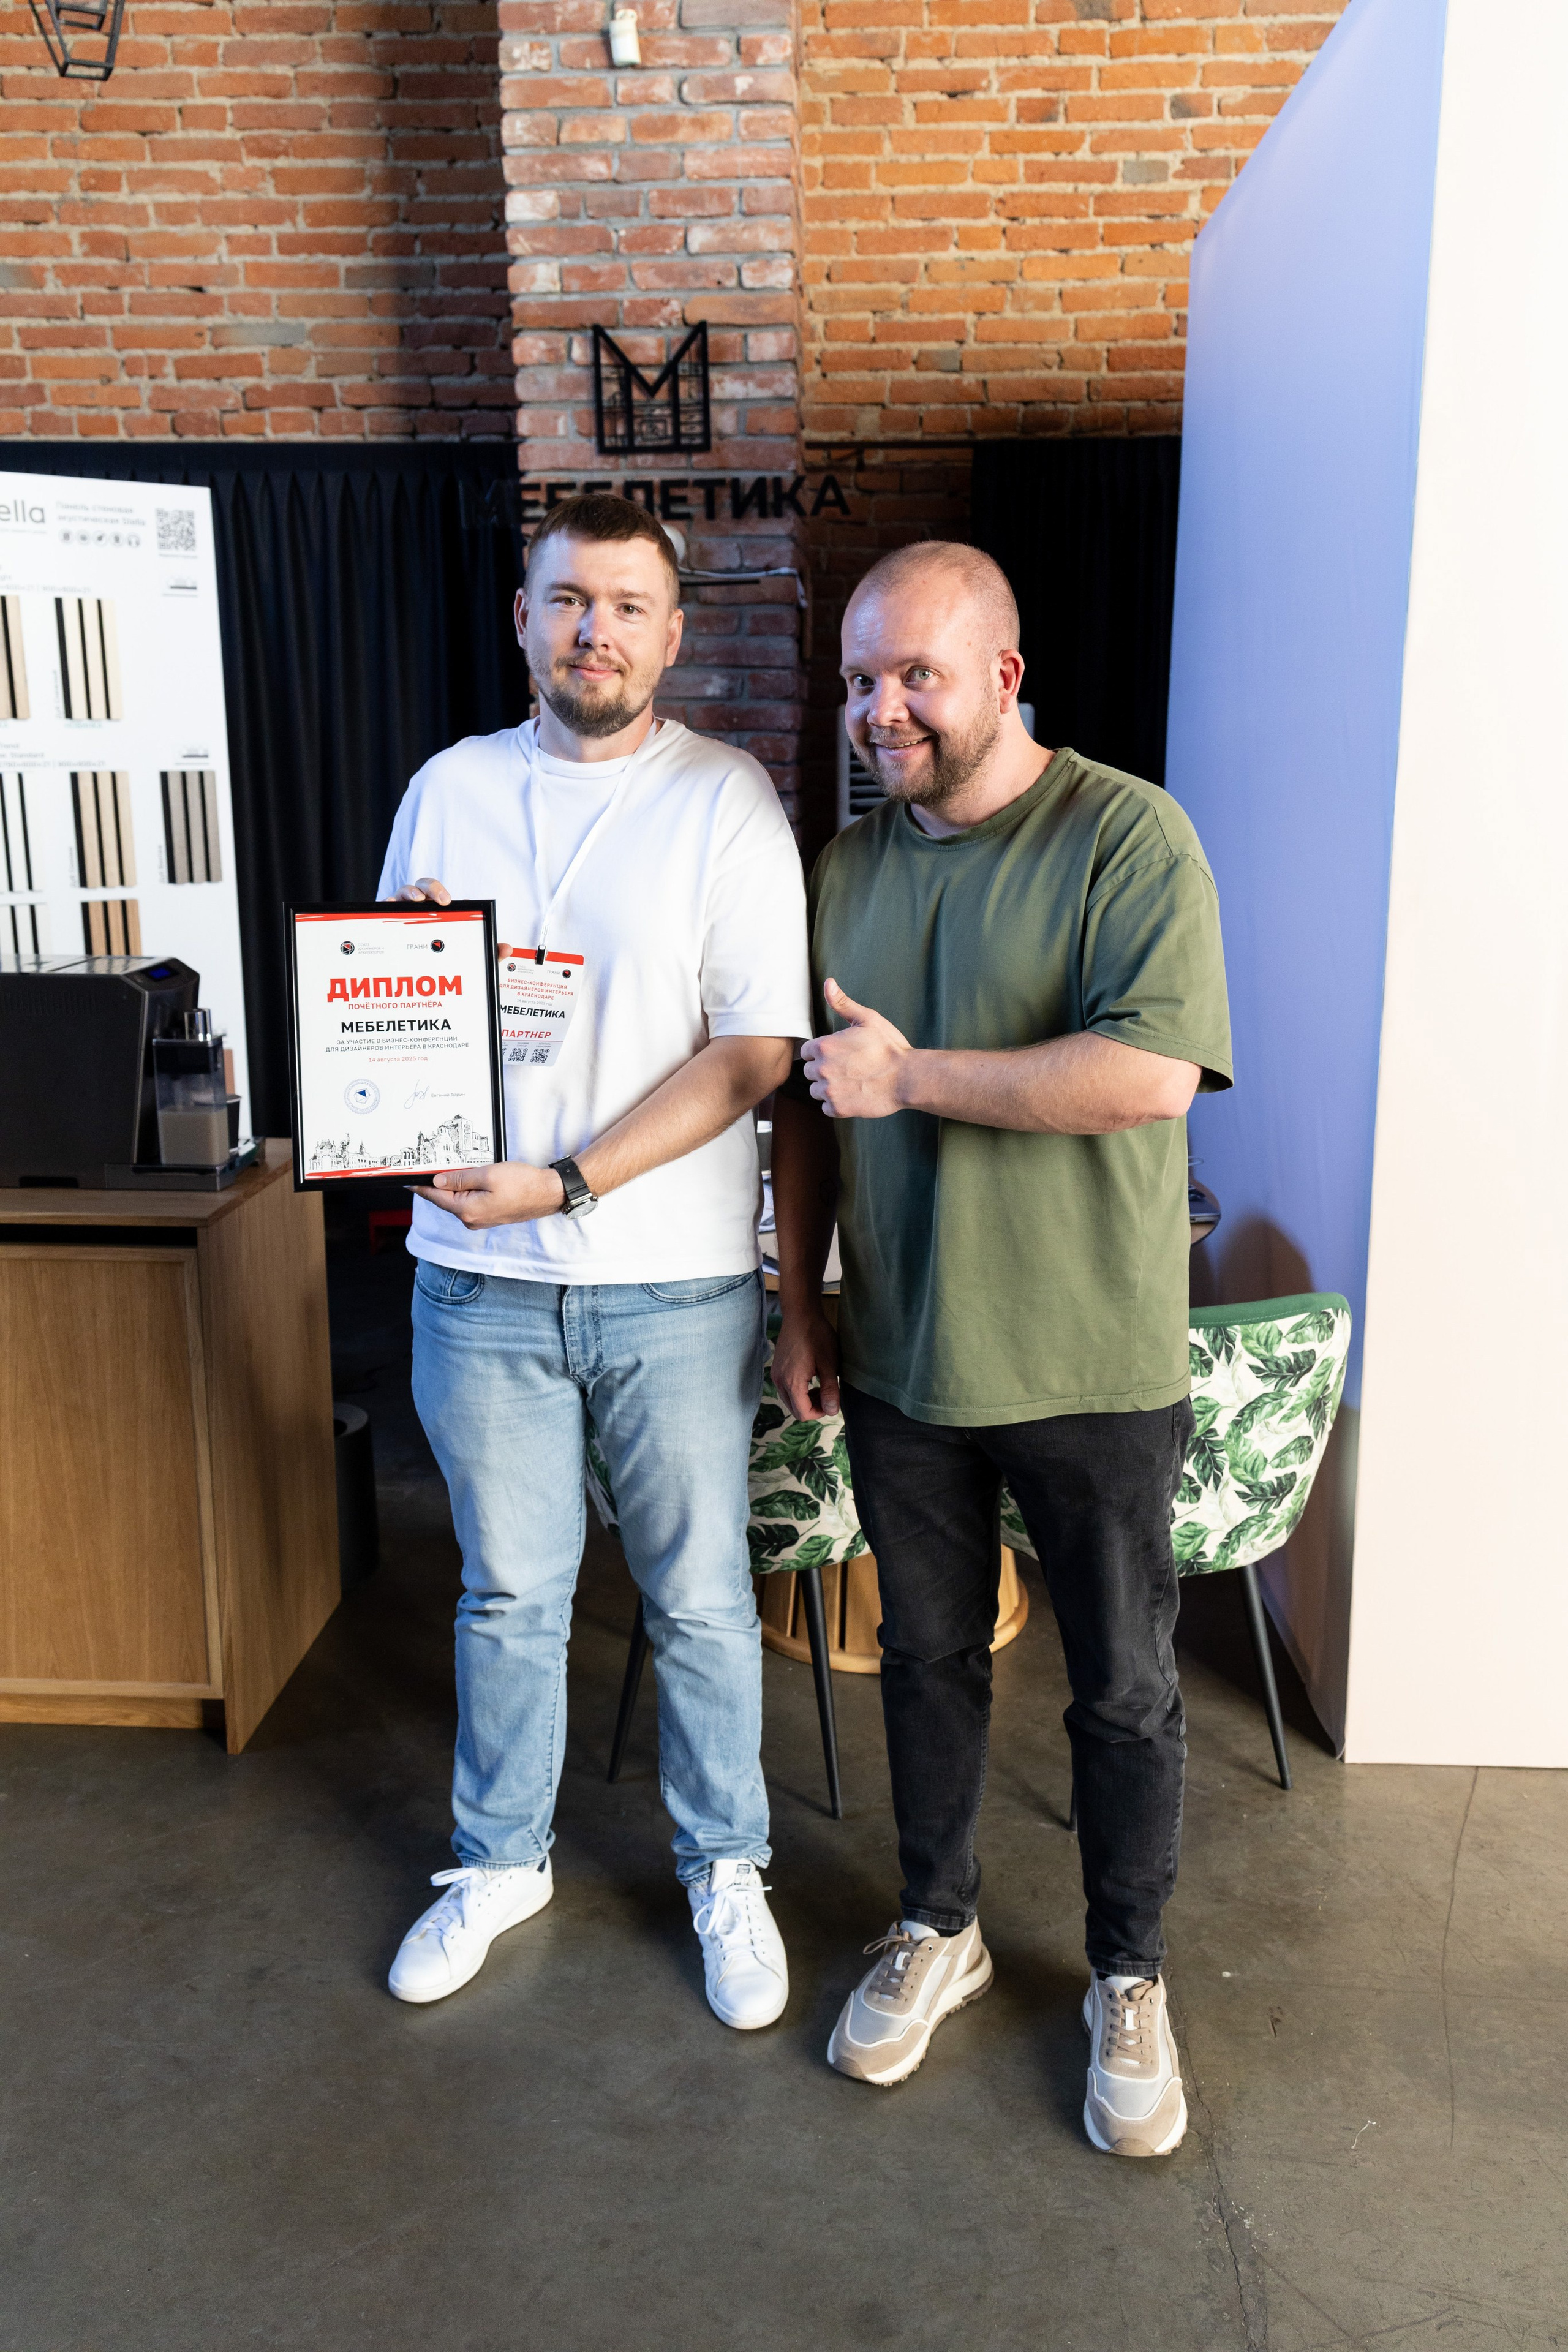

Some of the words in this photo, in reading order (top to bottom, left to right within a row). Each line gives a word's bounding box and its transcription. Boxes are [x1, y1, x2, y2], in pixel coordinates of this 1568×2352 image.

[327, 975, 462, 1003] ДИПЛОМ
[507, 978, 567, 989] БИЗНЕС-КОНФЕРЕНЦИЯ
[510, 984, 544, 993] ДИЗАЙНЕРОВ
[400, 1000, 443, 1009] ПАРТНЁРА
[500, 1005, 565, 1019] МЕБЕЛЕТИКА
[341, 1019, 451, 1033] МЕБЕЛЕТИКА
[502, 1029, 552, 1038] ПАРТНЕР
